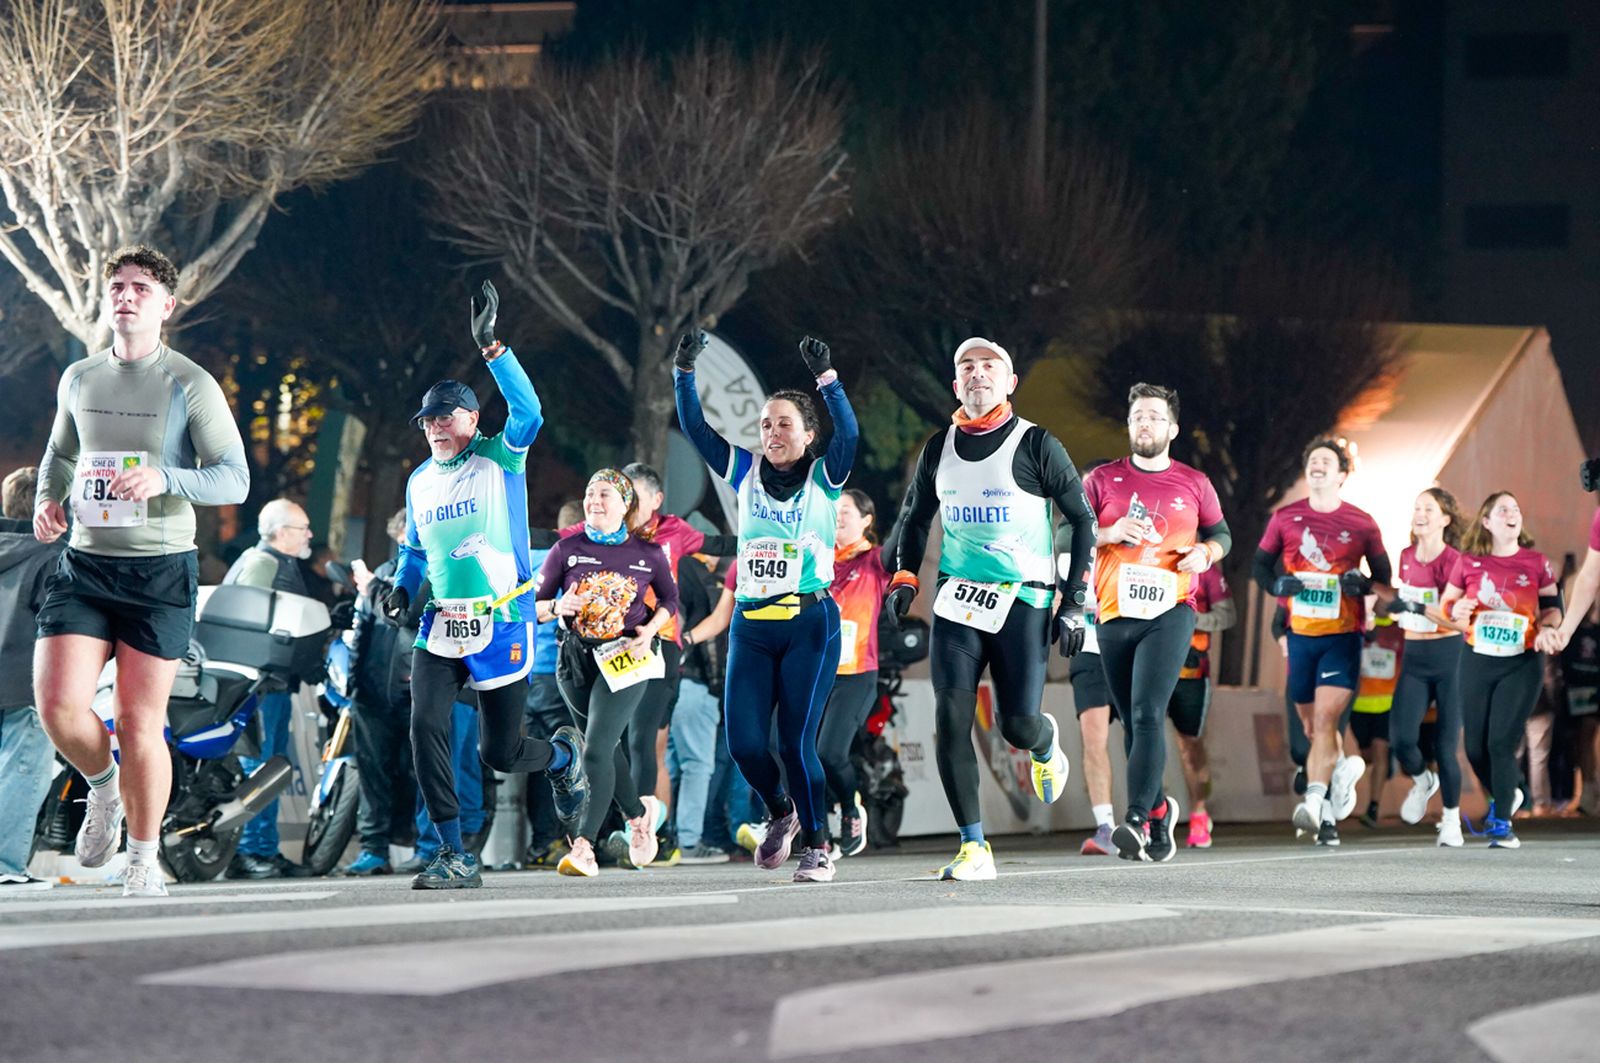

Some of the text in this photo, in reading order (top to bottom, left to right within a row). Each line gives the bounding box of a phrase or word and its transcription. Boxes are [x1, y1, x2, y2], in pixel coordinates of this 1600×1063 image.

[83, 478, 126, 501] 692
[436, 497, 478, 522] GILETE
[962, 506, 1011, 523] GILETE
[747, 559, 788, 579] 1549
[954, 583, 999, 611] 5746
[1129, 584, 1166, 603] 5087
[444, 618, 481, 639] 1669
[1482, 625, 1519, 644] 13754
